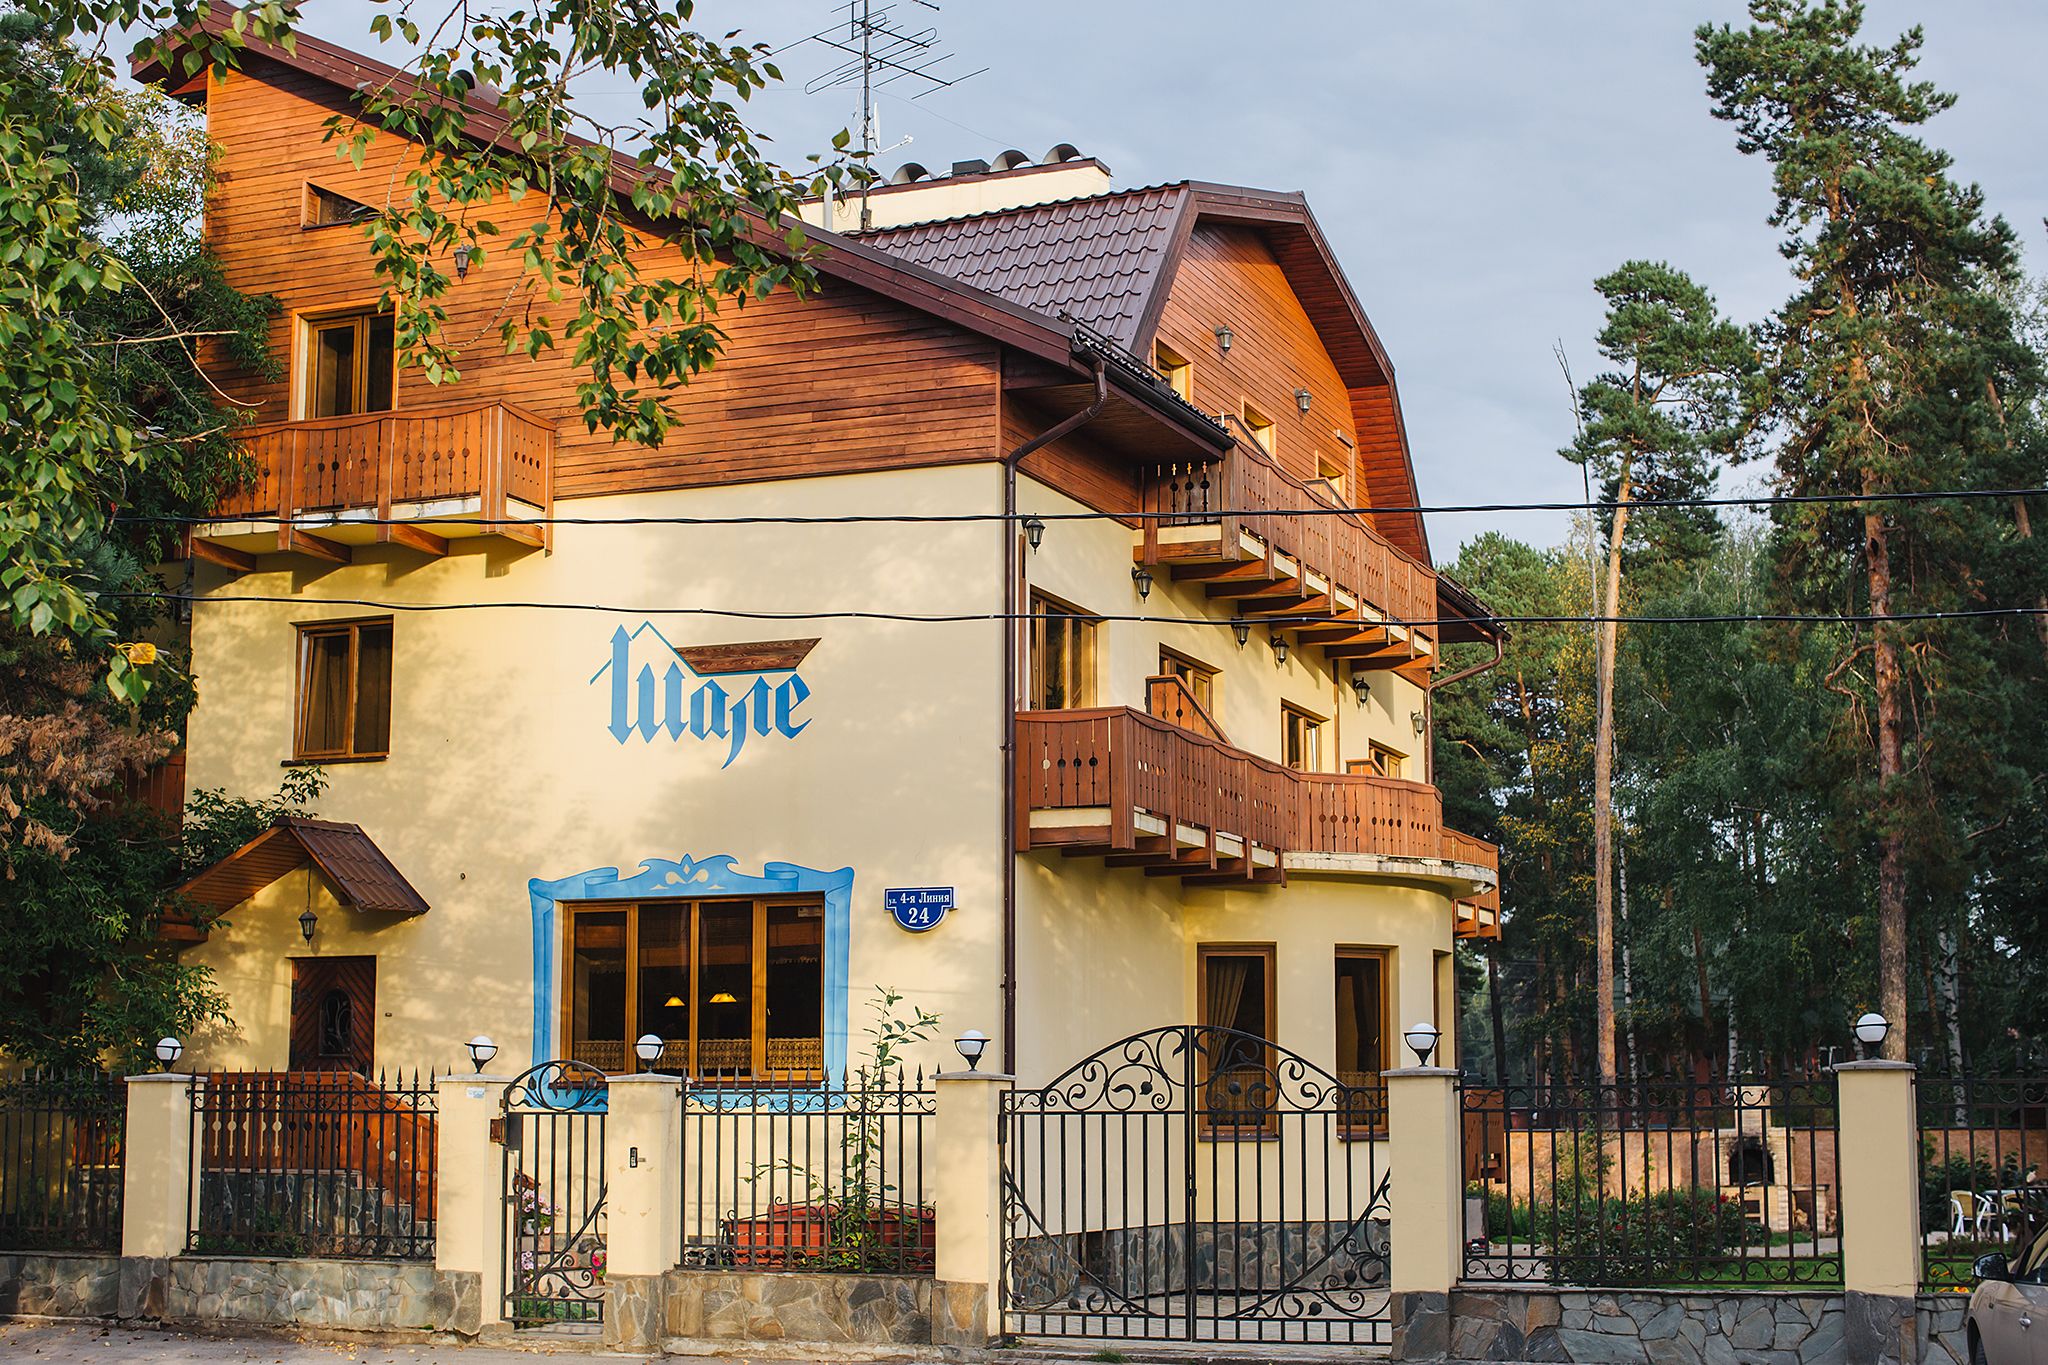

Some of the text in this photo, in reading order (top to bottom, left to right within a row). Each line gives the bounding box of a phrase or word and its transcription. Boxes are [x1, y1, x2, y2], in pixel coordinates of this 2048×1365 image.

[607, 623, 813, 770] Шале
[900, 892, 916, 904] 4-я
[918, 892, 950, 904] Линия
[908, 907, 930, 924] 24
